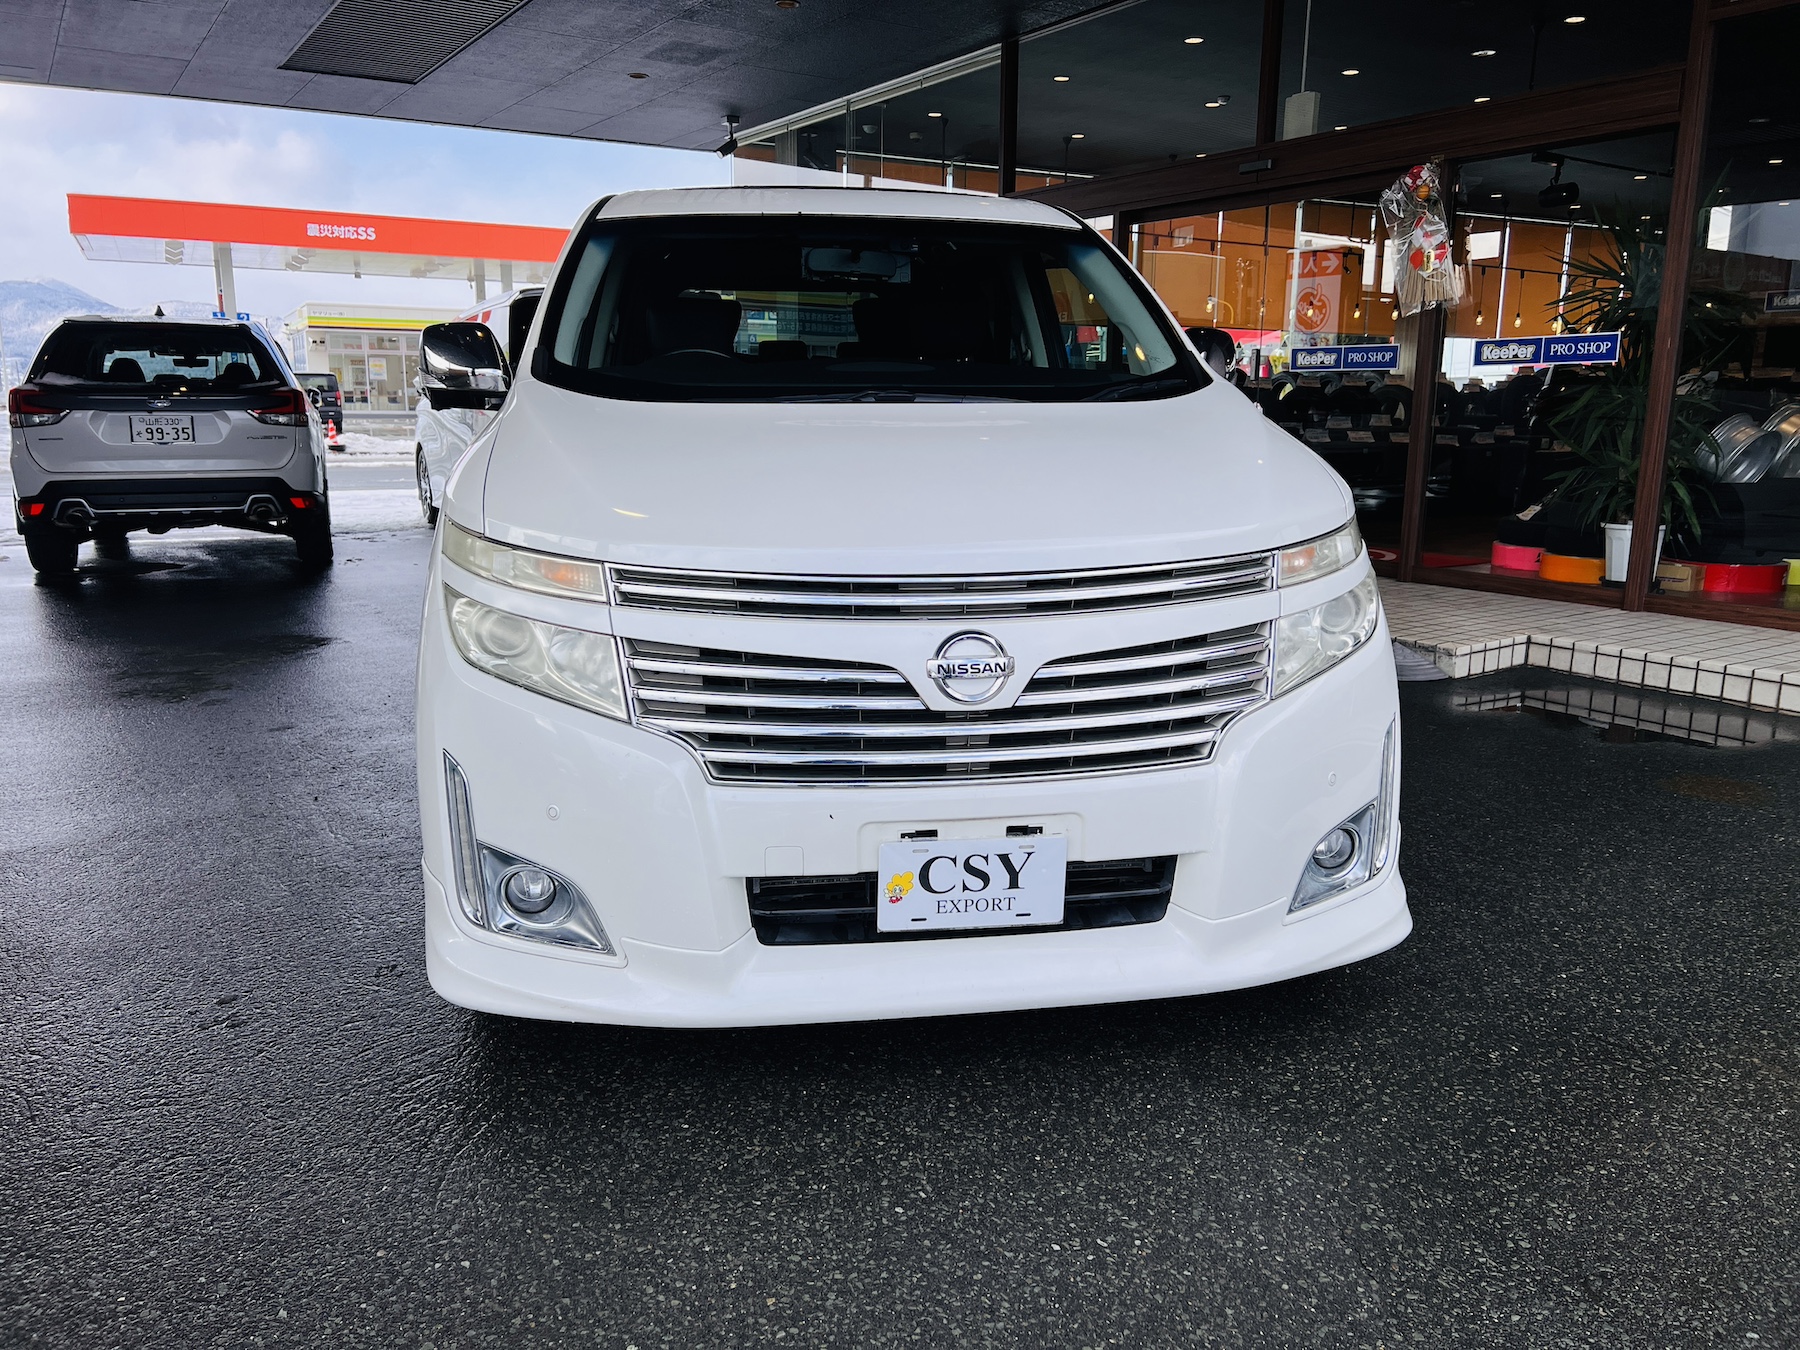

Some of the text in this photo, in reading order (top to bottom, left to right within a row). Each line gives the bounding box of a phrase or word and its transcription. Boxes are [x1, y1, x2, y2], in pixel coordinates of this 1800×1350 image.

[306, 223, 377, 241] 震災対応SS
[1297, 351, 1394, 366] KeePer PRO SHOP
[1482, 341, 1612, 361] KeePer PRO SHOP
[164, 418, 180, 426] 330
[145, 427, 190, 441] 99-35
[937, 662, 1006, 675] NISSAN
[918, 851, 1036, 894] CSY
[936, 896, 1017, 914] EXPORT
